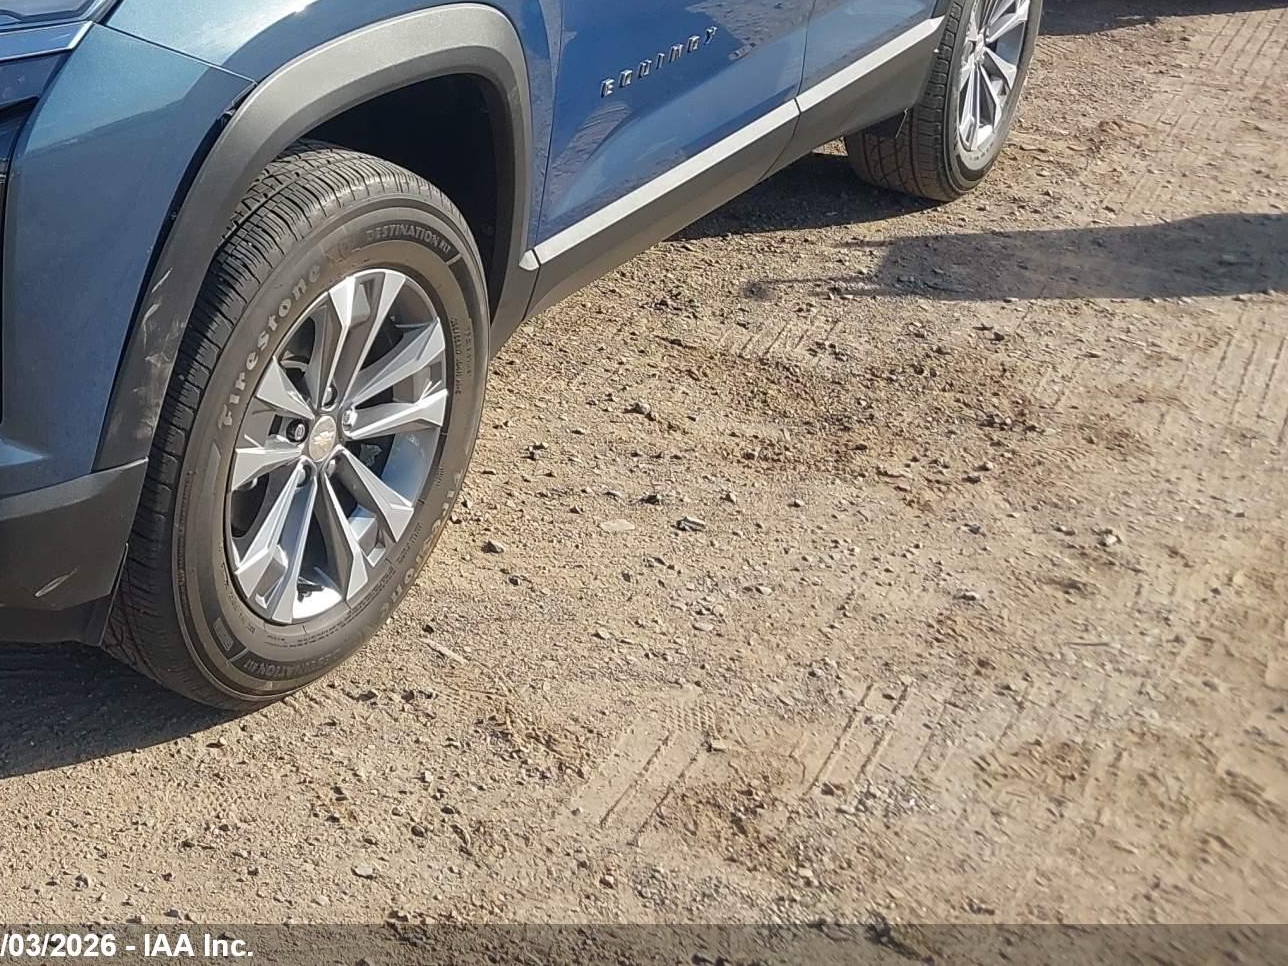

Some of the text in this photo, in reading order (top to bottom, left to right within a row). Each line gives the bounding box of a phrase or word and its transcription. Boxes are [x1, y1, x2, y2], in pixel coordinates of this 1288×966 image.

[599, 24, 719, 99] EQUINOX
[365, 224, 441, 249] DESTINATION
[218, 262, 323, 430] Firestone
